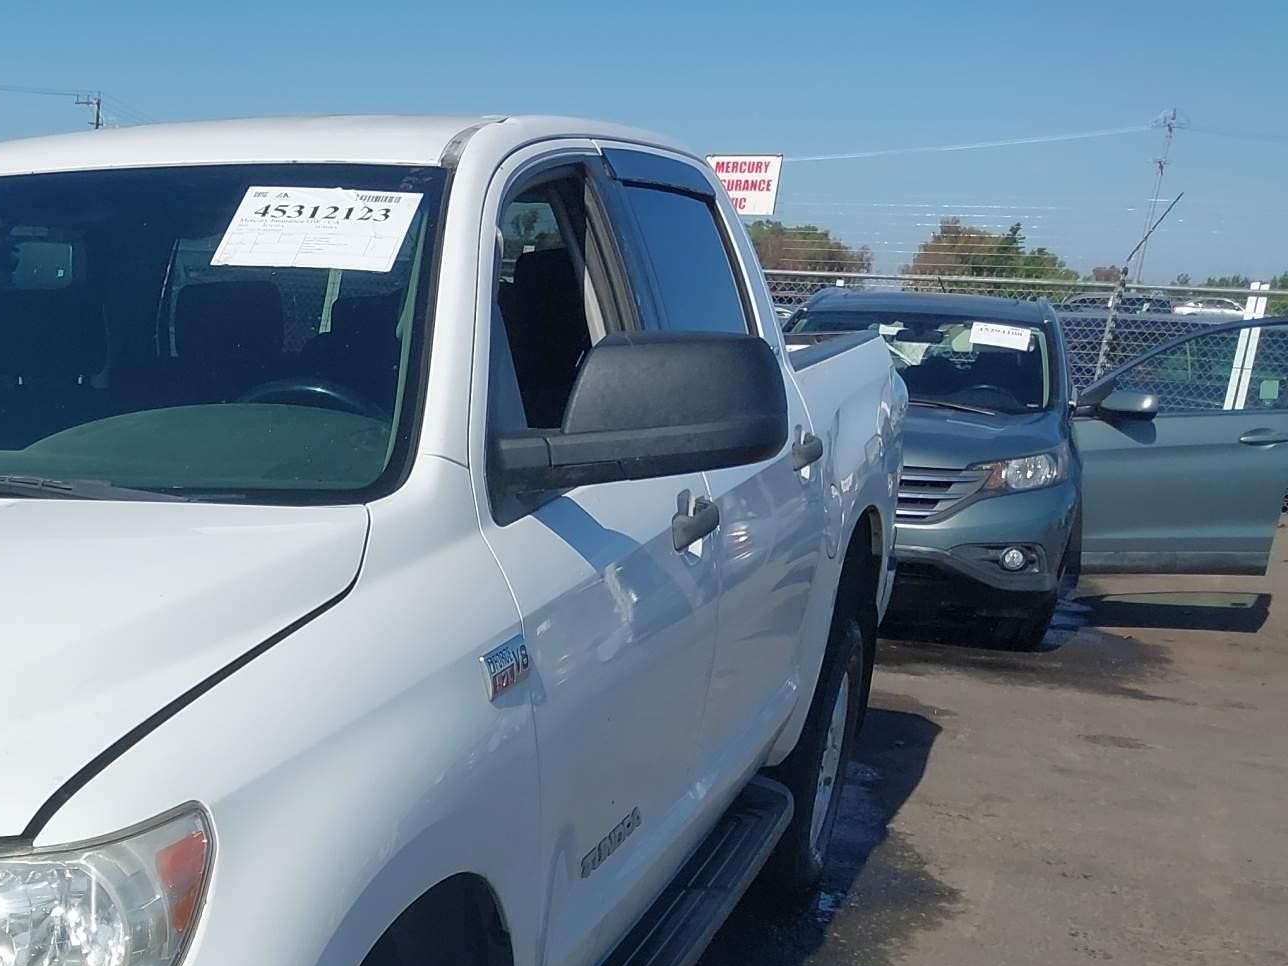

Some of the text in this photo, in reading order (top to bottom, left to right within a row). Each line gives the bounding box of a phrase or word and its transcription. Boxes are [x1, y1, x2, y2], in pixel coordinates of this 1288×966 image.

[715, 160, 771, 174] MERCURY
[720, 179, 773, 192] SURANCE
[254, 204, 391, 222] 45312123
[512, 644, 529, 672] V8
